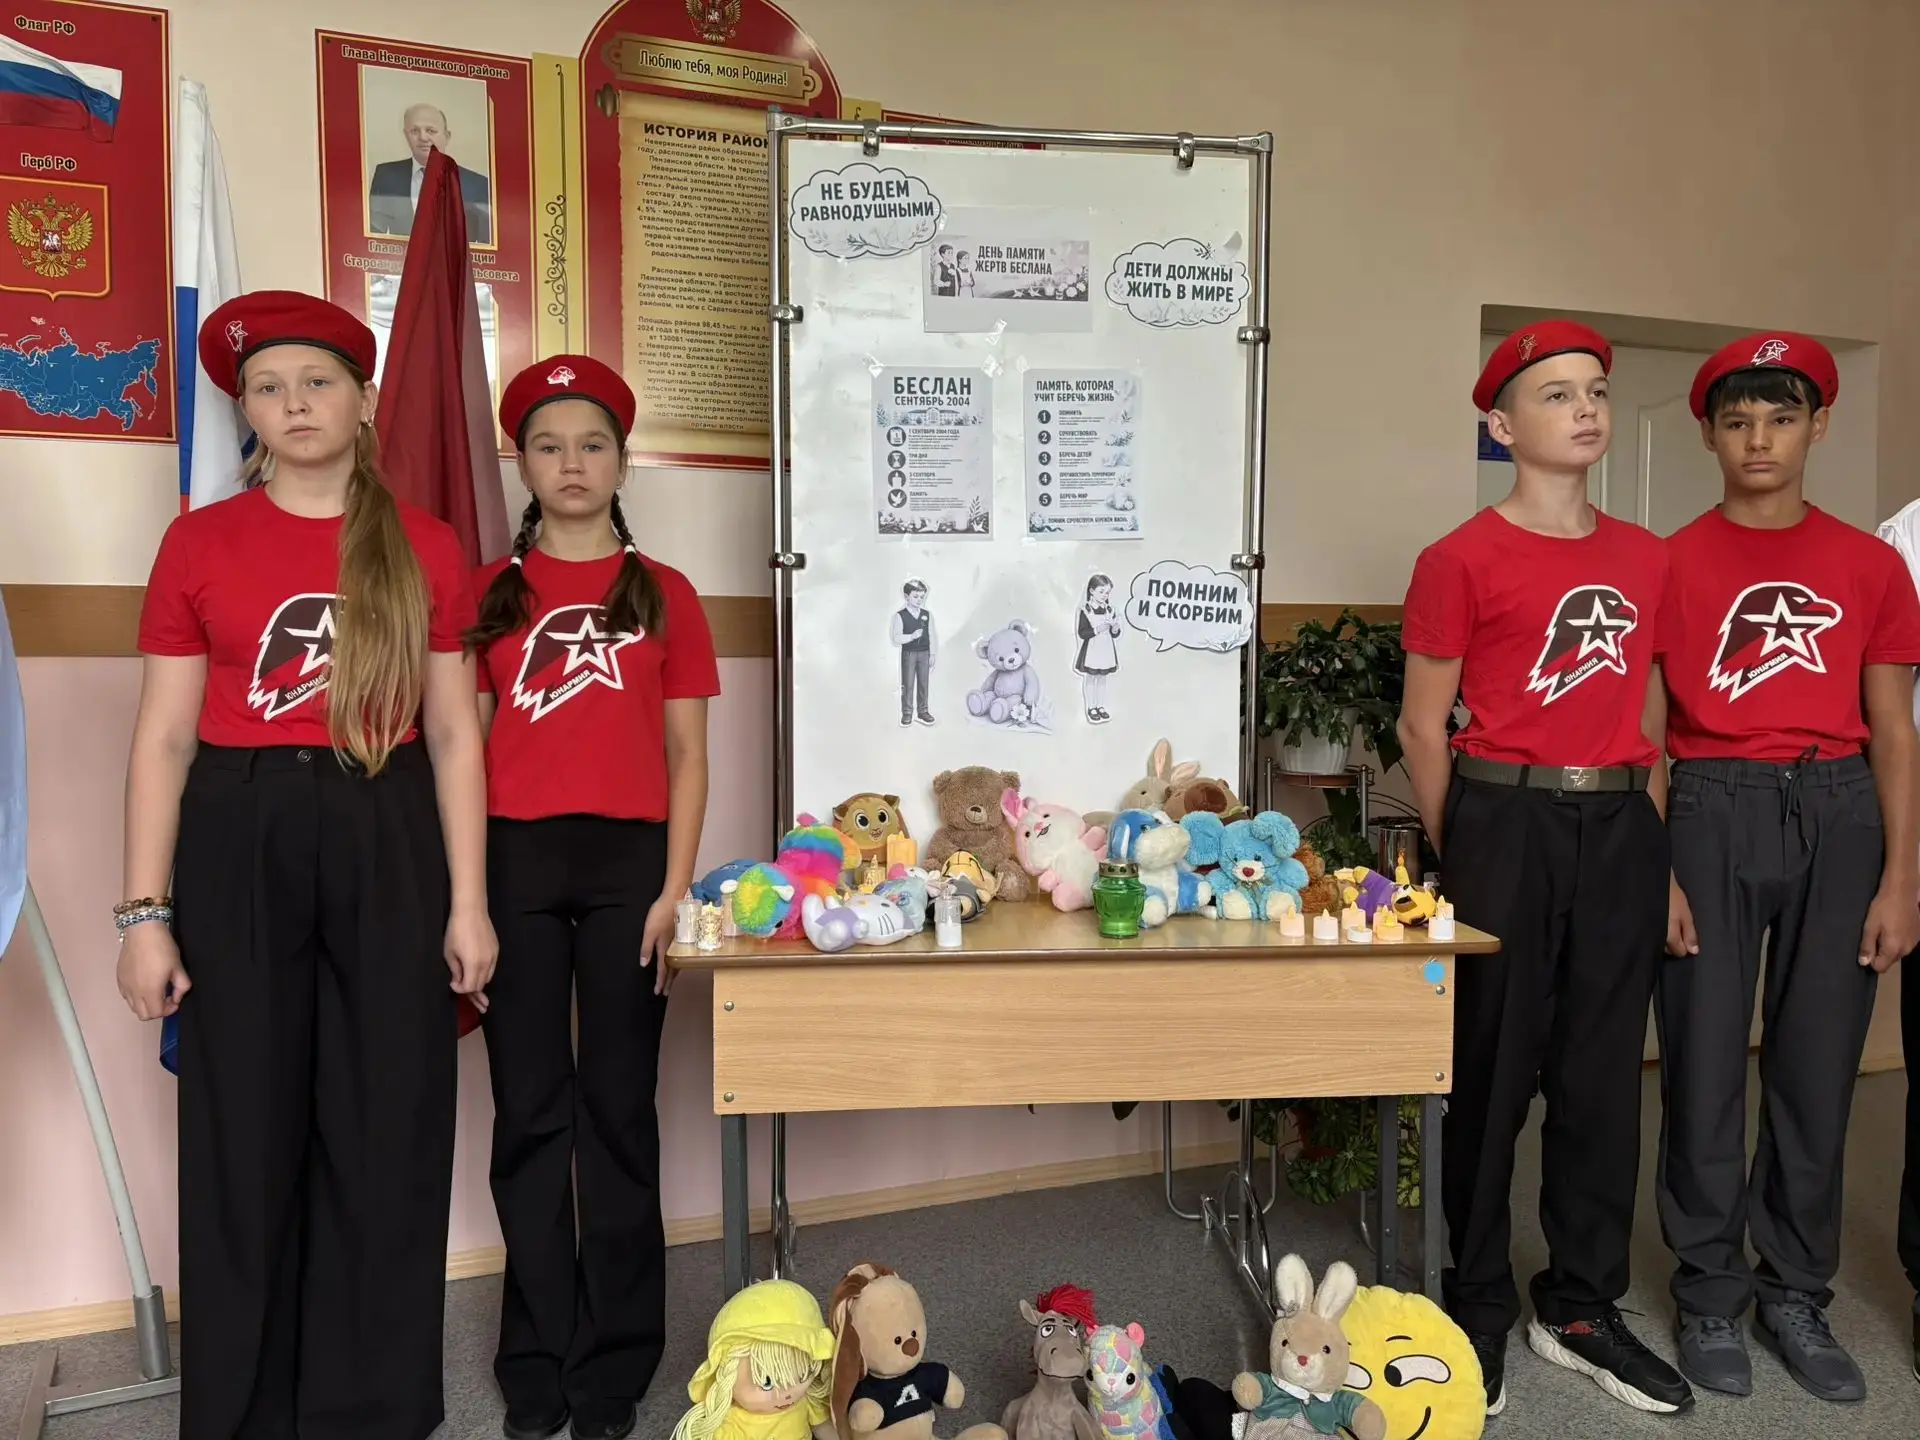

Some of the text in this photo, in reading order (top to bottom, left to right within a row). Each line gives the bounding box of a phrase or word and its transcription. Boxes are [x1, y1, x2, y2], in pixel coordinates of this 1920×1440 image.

[15, 15, 75, 35] Флаг РФ
[342, 44, 510, 79] Глава Неверкинского района
[638, 50, 788, 87] Люблю тебя, моя Родина!
[644, 123, 717, 142] ИСТОРИЯ
[21, 153, 77, 172] Герб РФ
[649, 154, 692, 166] Пензенской
[651, 163, 706, 176] Неверкинского
[642, 172, 688, 183] уникальный
[821, 180, 910, 201] НЕ БУДЕМ
[800, 201, 934, 221] РАВНОДУШНЫМИ
[368, 240, 403, 255] Глава
[978, 245, 1045, 260] ДЕНЬ ПАМЯТИ
[975, 260, 1052, 275] ЖЕРТВ БЕСЛАНА
[1124, 261, 1233, 282] ДЕТИ ДОЛЖНЫ
[1127, 281, 1234, 302] ЖИТЬ В МИРЕ
[893, 376, 971, 395] БЕСЛАН
[1036, 380, 1114, 391] ПАМЯТЬ, КОТОРАЯ
[894, 396, 970, 406] СЕНТЯБРЬ 2004
[1034, 393, 1115, 402] УЧИТ БЕРЕЧЬ ЖИЗНЬ
[1148, 579, 1238, 604] ПОМНИМ
[1138, 600, 1242, 624] И СКОРБИМ
[1564, 657, 1599, 684] ЮНАРМИЯ
[1747, 652, 1789, 679] ЮНАРМИЯ
[549, 669, 591, 700] ЮНАРМИЯ
